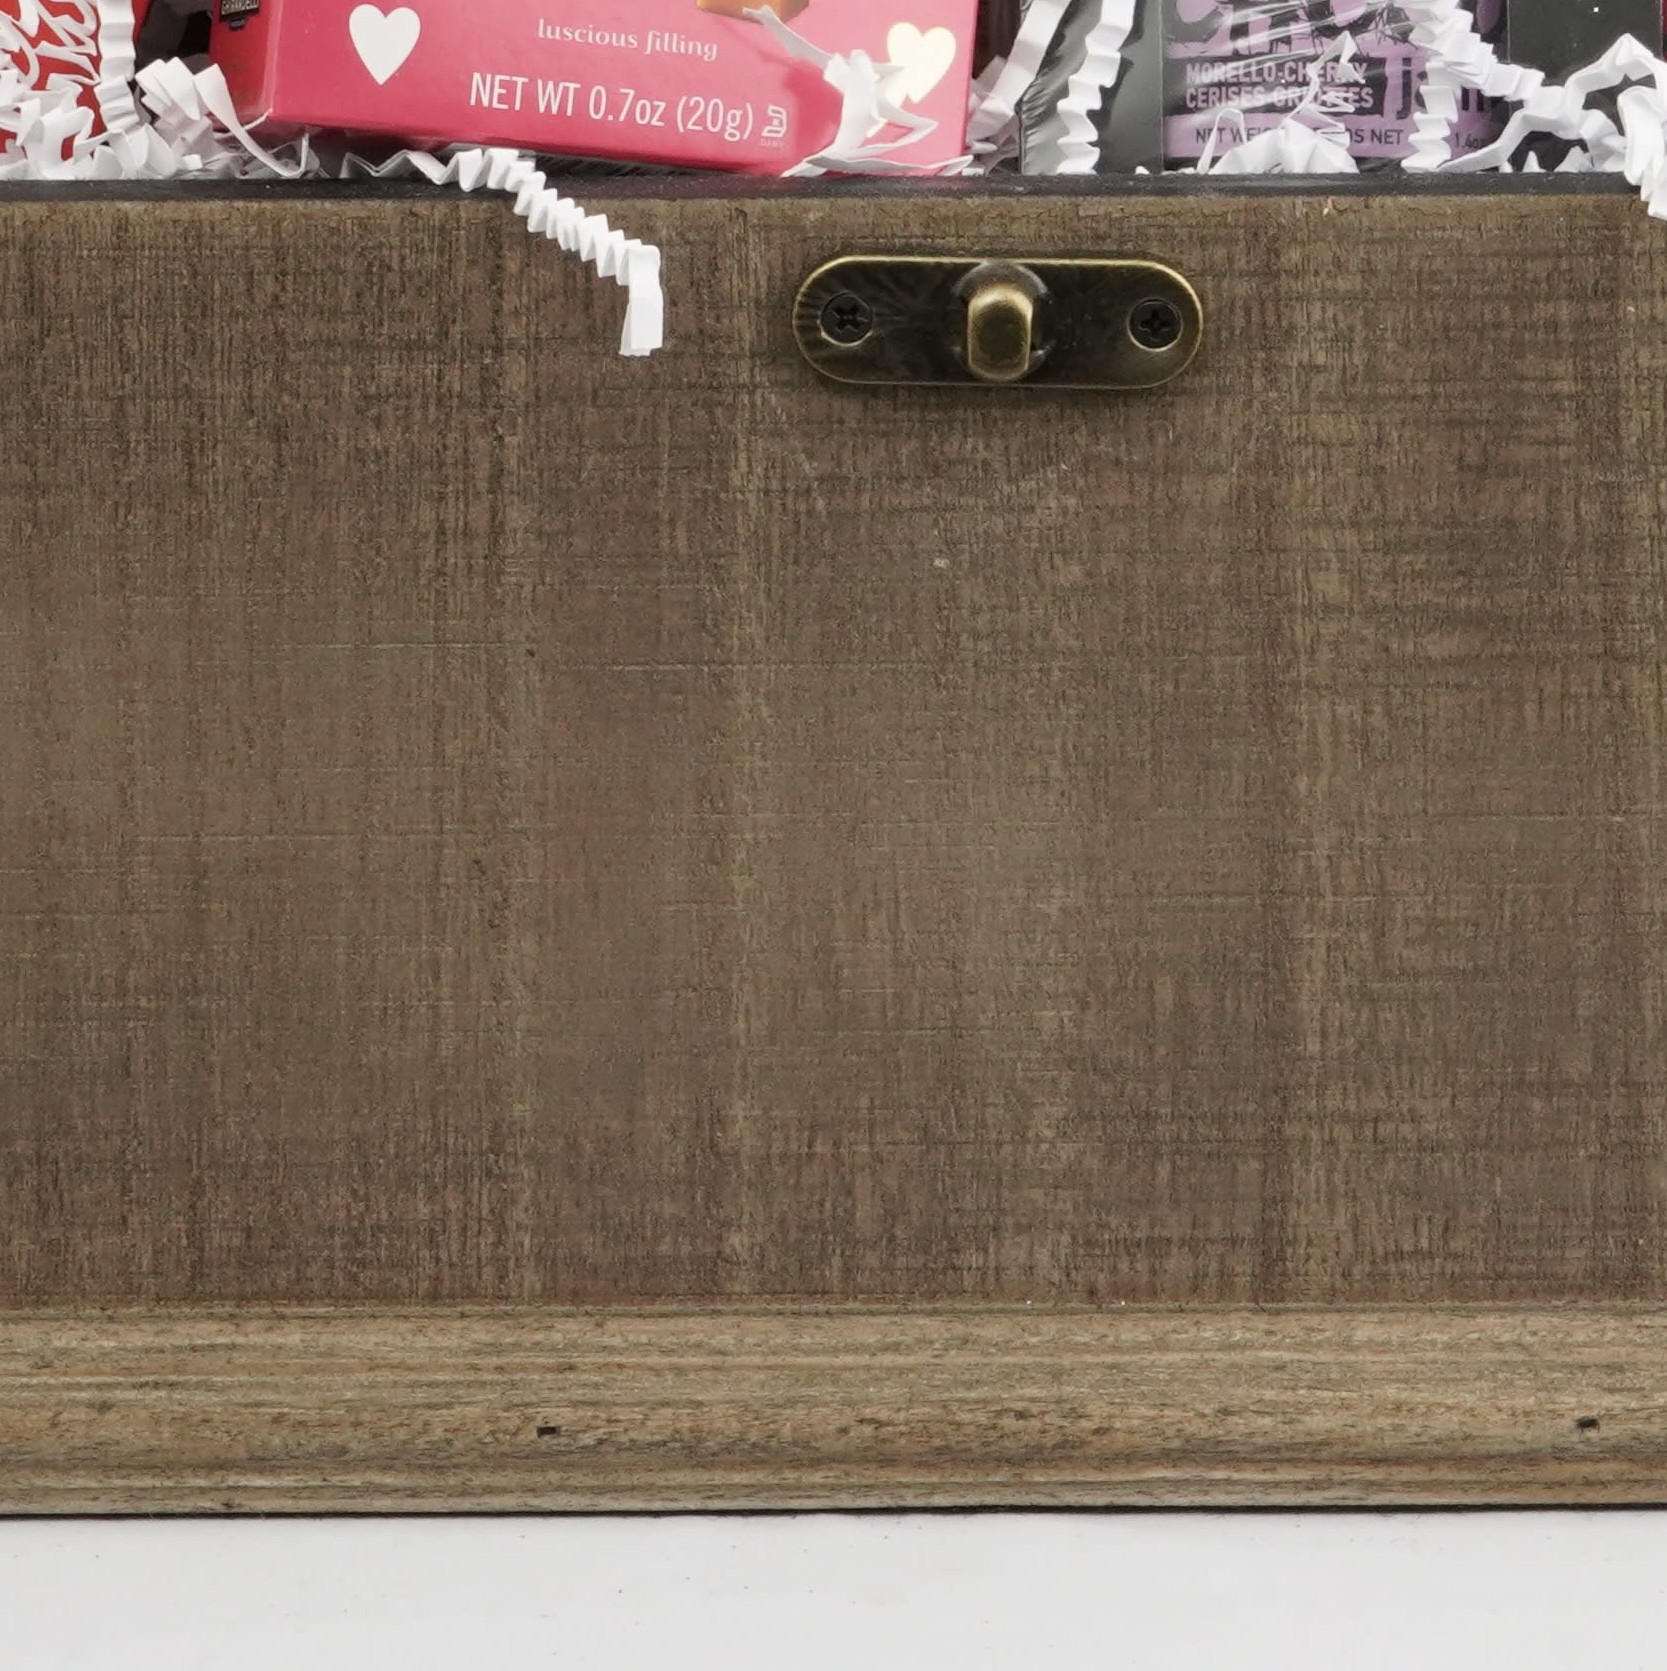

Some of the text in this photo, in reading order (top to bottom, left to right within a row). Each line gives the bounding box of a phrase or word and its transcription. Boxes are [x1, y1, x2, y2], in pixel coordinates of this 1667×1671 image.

[537, 17, 719, 62] luscious filling
[469, 70, 754, 142] NET WT 0.7oz (20g)
